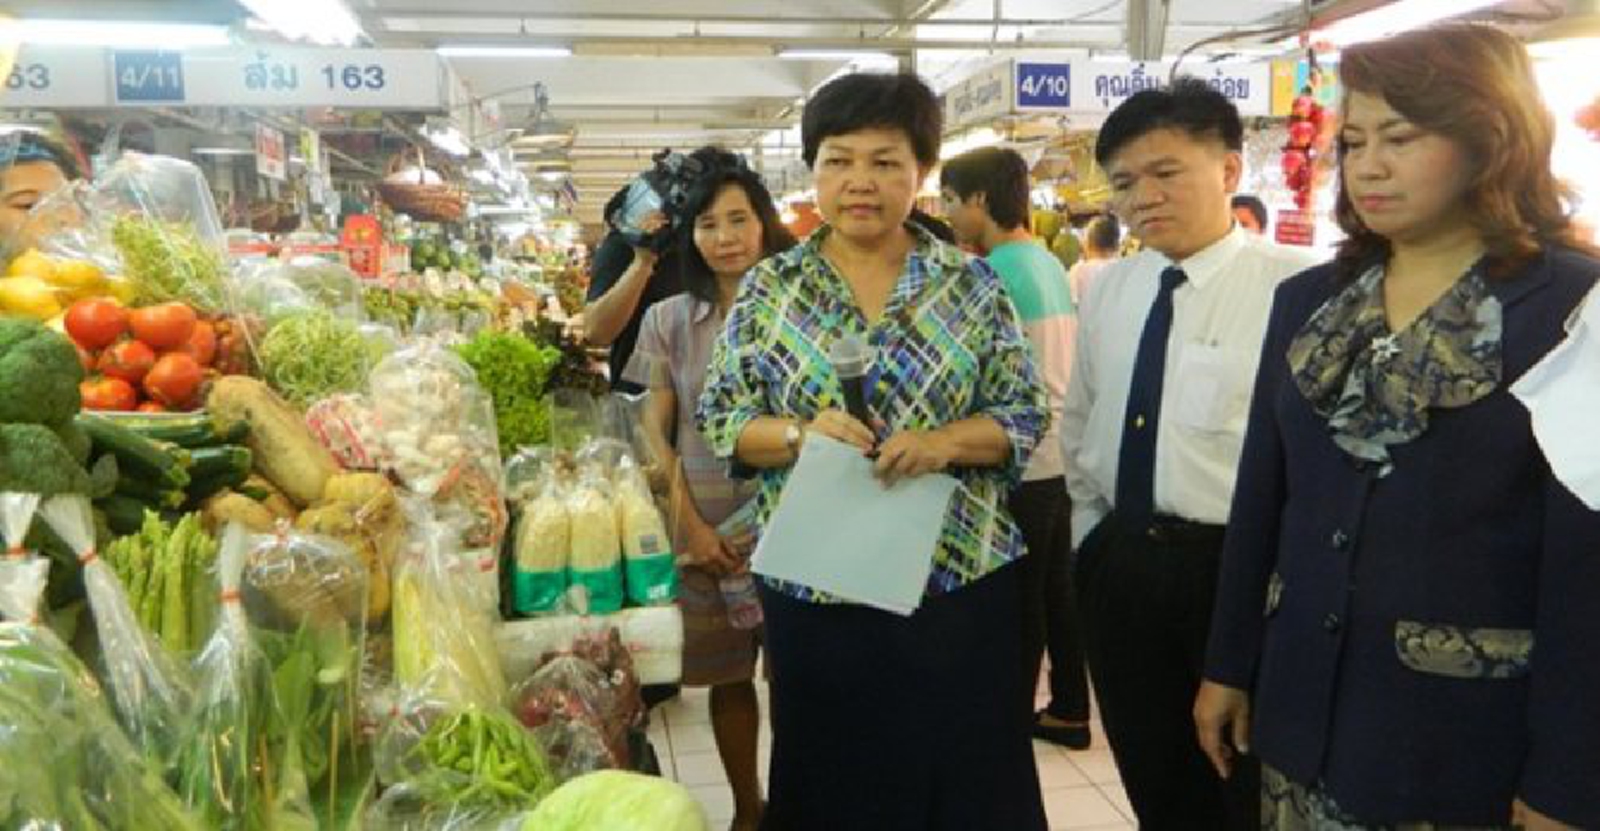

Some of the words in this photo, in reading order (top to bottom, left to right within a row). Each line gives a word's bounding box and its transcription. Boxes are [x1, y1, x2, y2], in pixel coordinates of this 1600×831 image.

[121, 64, 180, 89] 4/11
[321, 63, 385, 90] 163
[1021, 75, 1067, 97] 4/10
